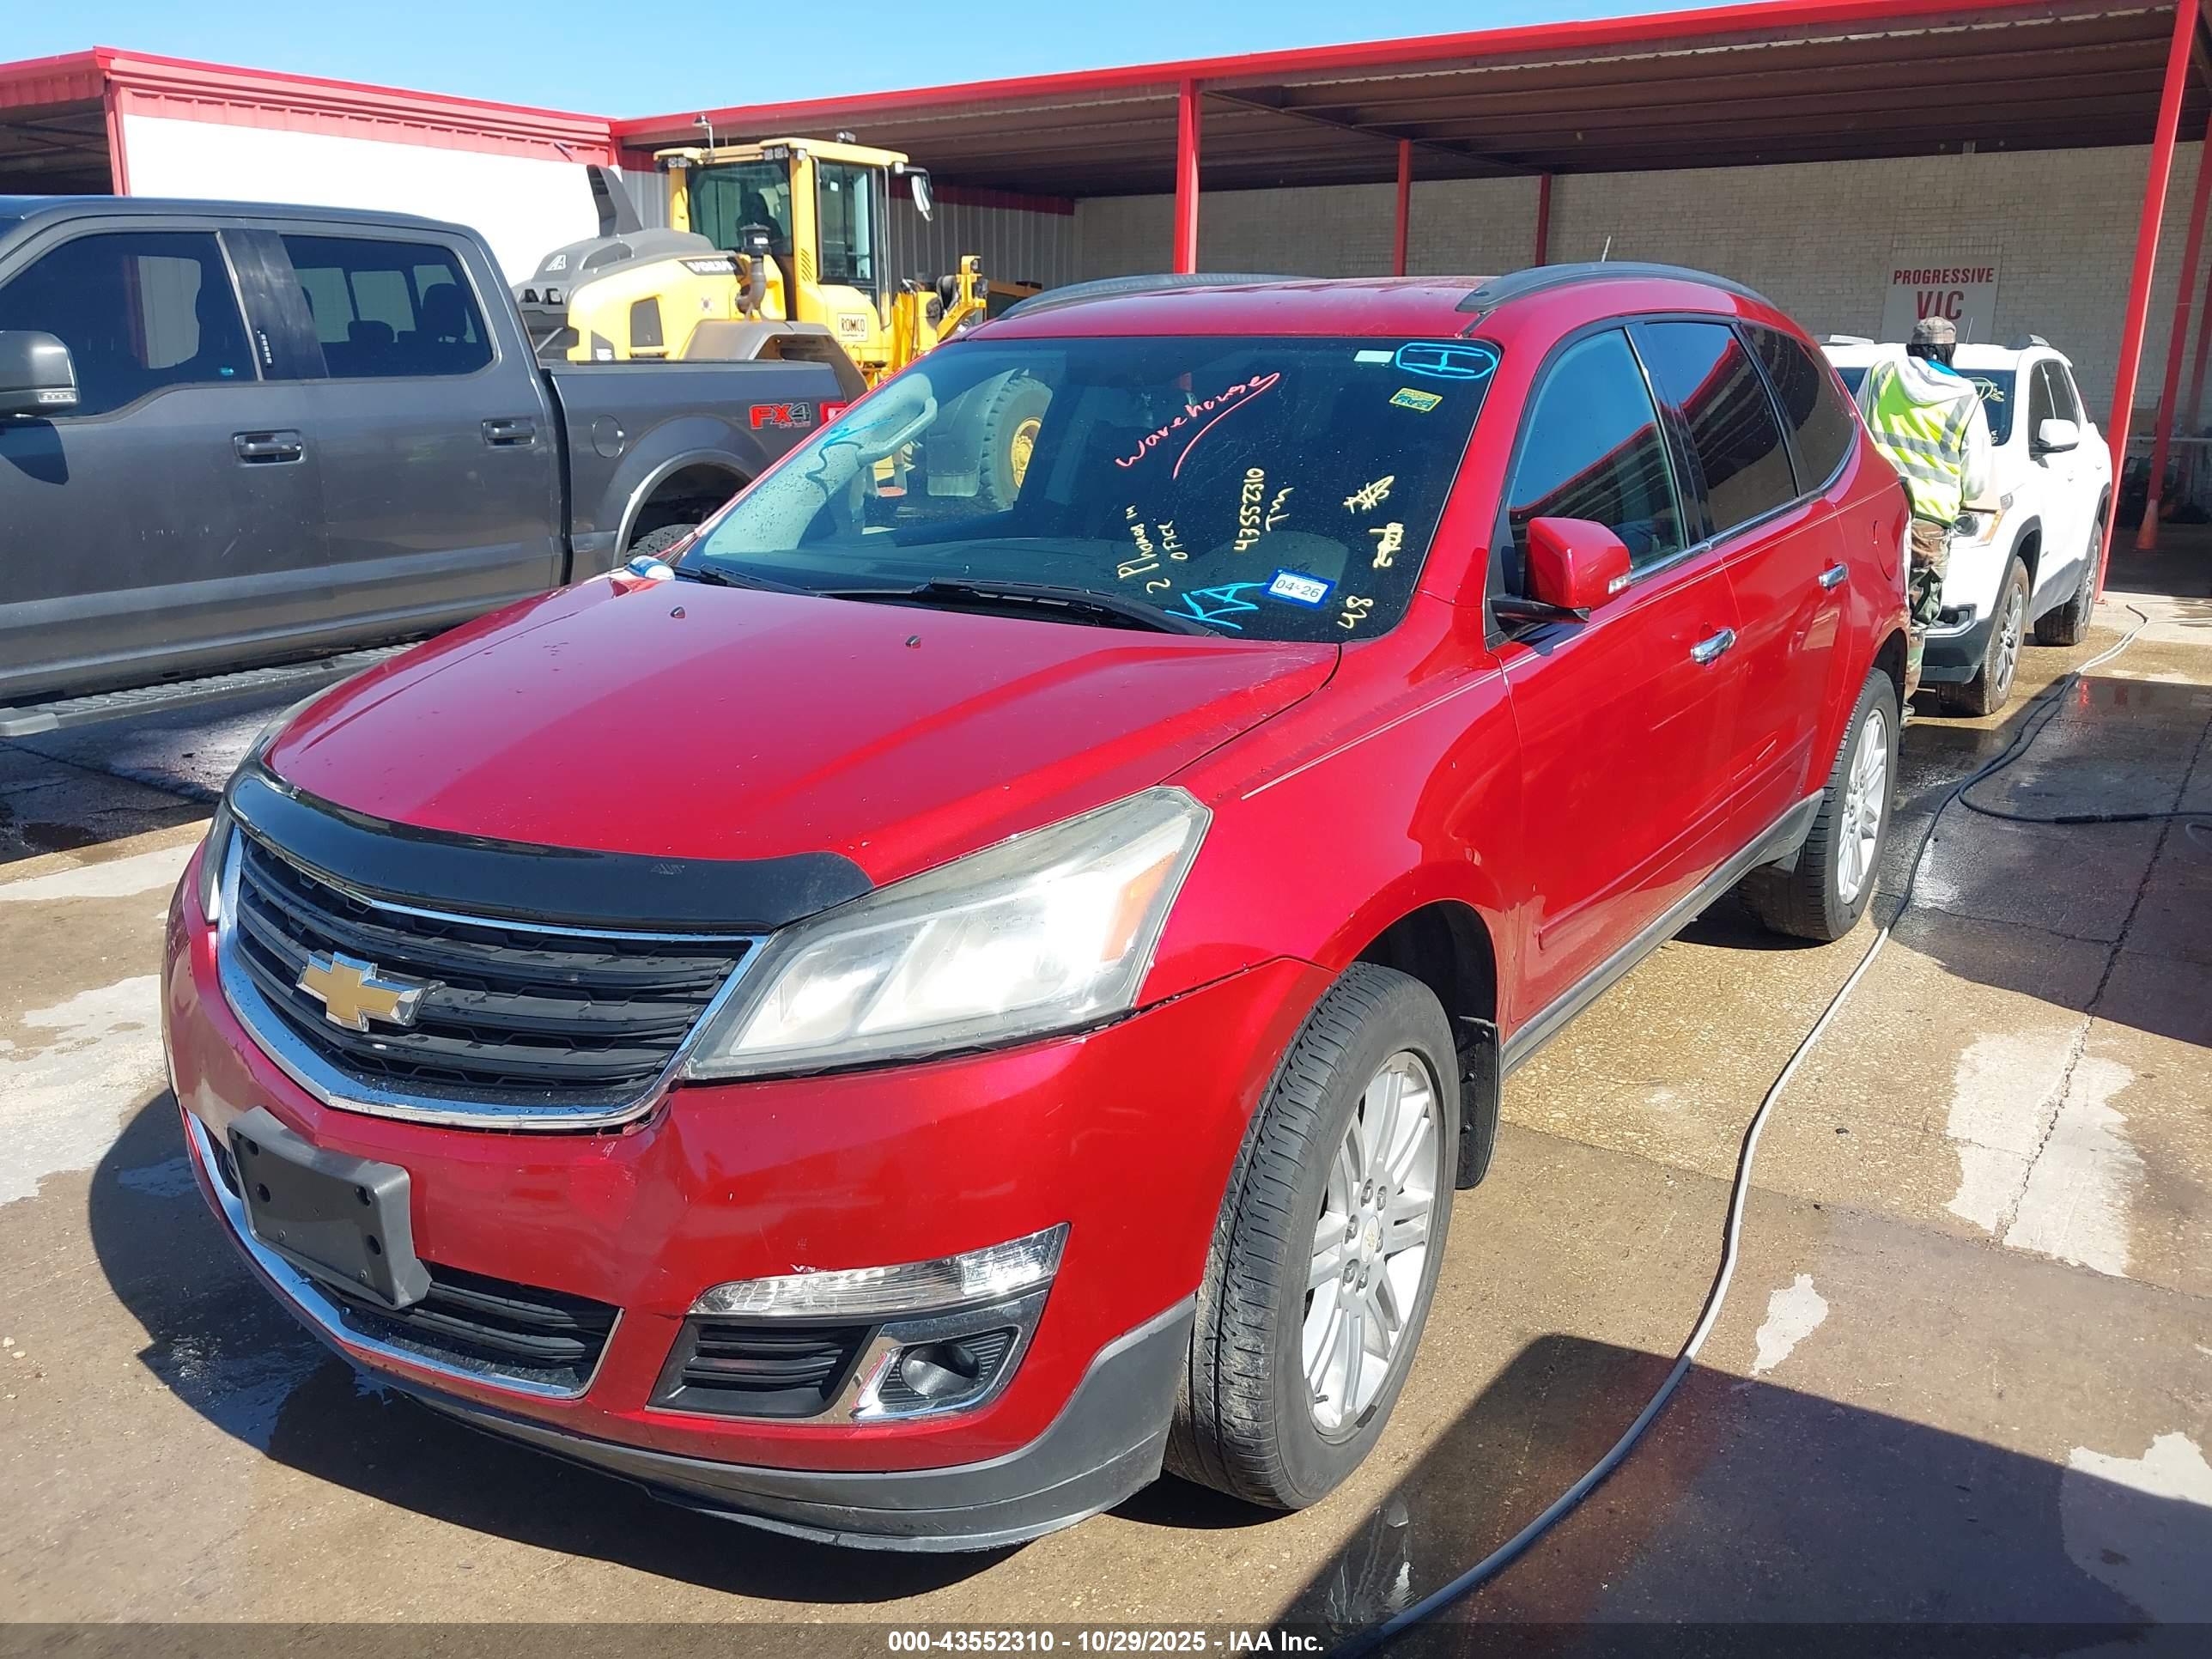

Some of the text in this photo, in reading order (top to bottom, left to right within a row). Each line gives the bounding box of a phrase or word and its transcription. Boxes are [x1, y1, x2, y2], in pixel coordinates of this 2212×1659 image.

[1893, 267, 1995, 284] PROGRESSIVE
[1917, 290, 1965, 320] VIC
[841, 317, 866, 332] ROMCO
[749, 402, 811, 429] FX4
[1233, 467, 1265, 550] 43552310
